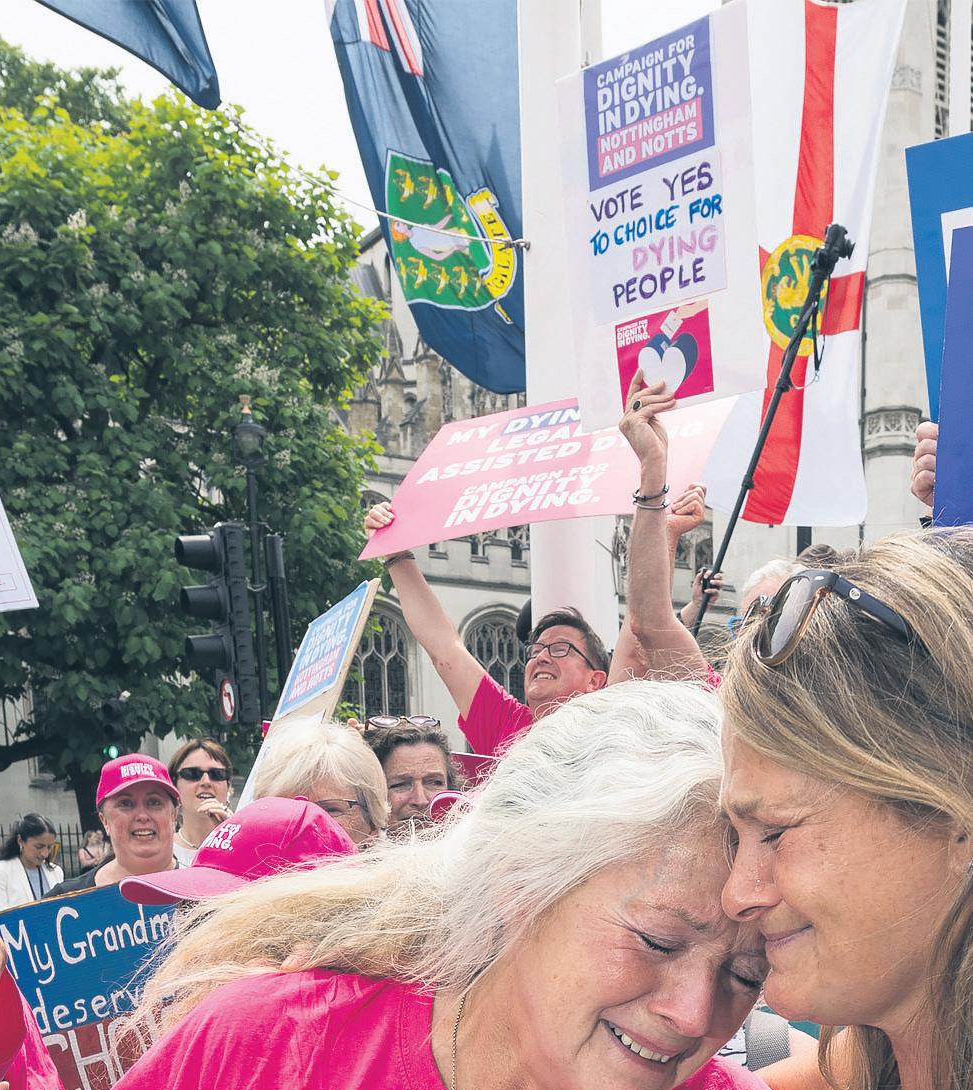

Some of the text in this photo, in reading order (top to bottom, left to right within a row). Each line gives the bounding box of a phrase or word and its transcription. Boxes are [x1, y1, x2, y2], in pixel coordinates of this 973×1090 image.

[597, 34, 695, 88] CAMPAIGN FOR
[597, 49, 696, 112] DIGNITY
[598, 75, 704, 135] IN DYING.
[600, 102, 697, 153] NOTTINGHAM
[602, 121, 697, 175] AND NOTTS
[590, 161, 714, 222] VOTE YES
[589, 193, 723, 256] TO CHOICE FOR
[632, 224, 719, 271] DYING
[613, 257, 706, 308] PEOPLE
[446, 422, 500, 446] MY
[416, 441, 582, 485] ASSISTED
[463, 462, 610, 495] CAMPAIGN FOR
[443, 488, 602, 528] IN DYING.
[453, 471, 606, 511] DIGNITY
[0, 919, 56, 984] My
